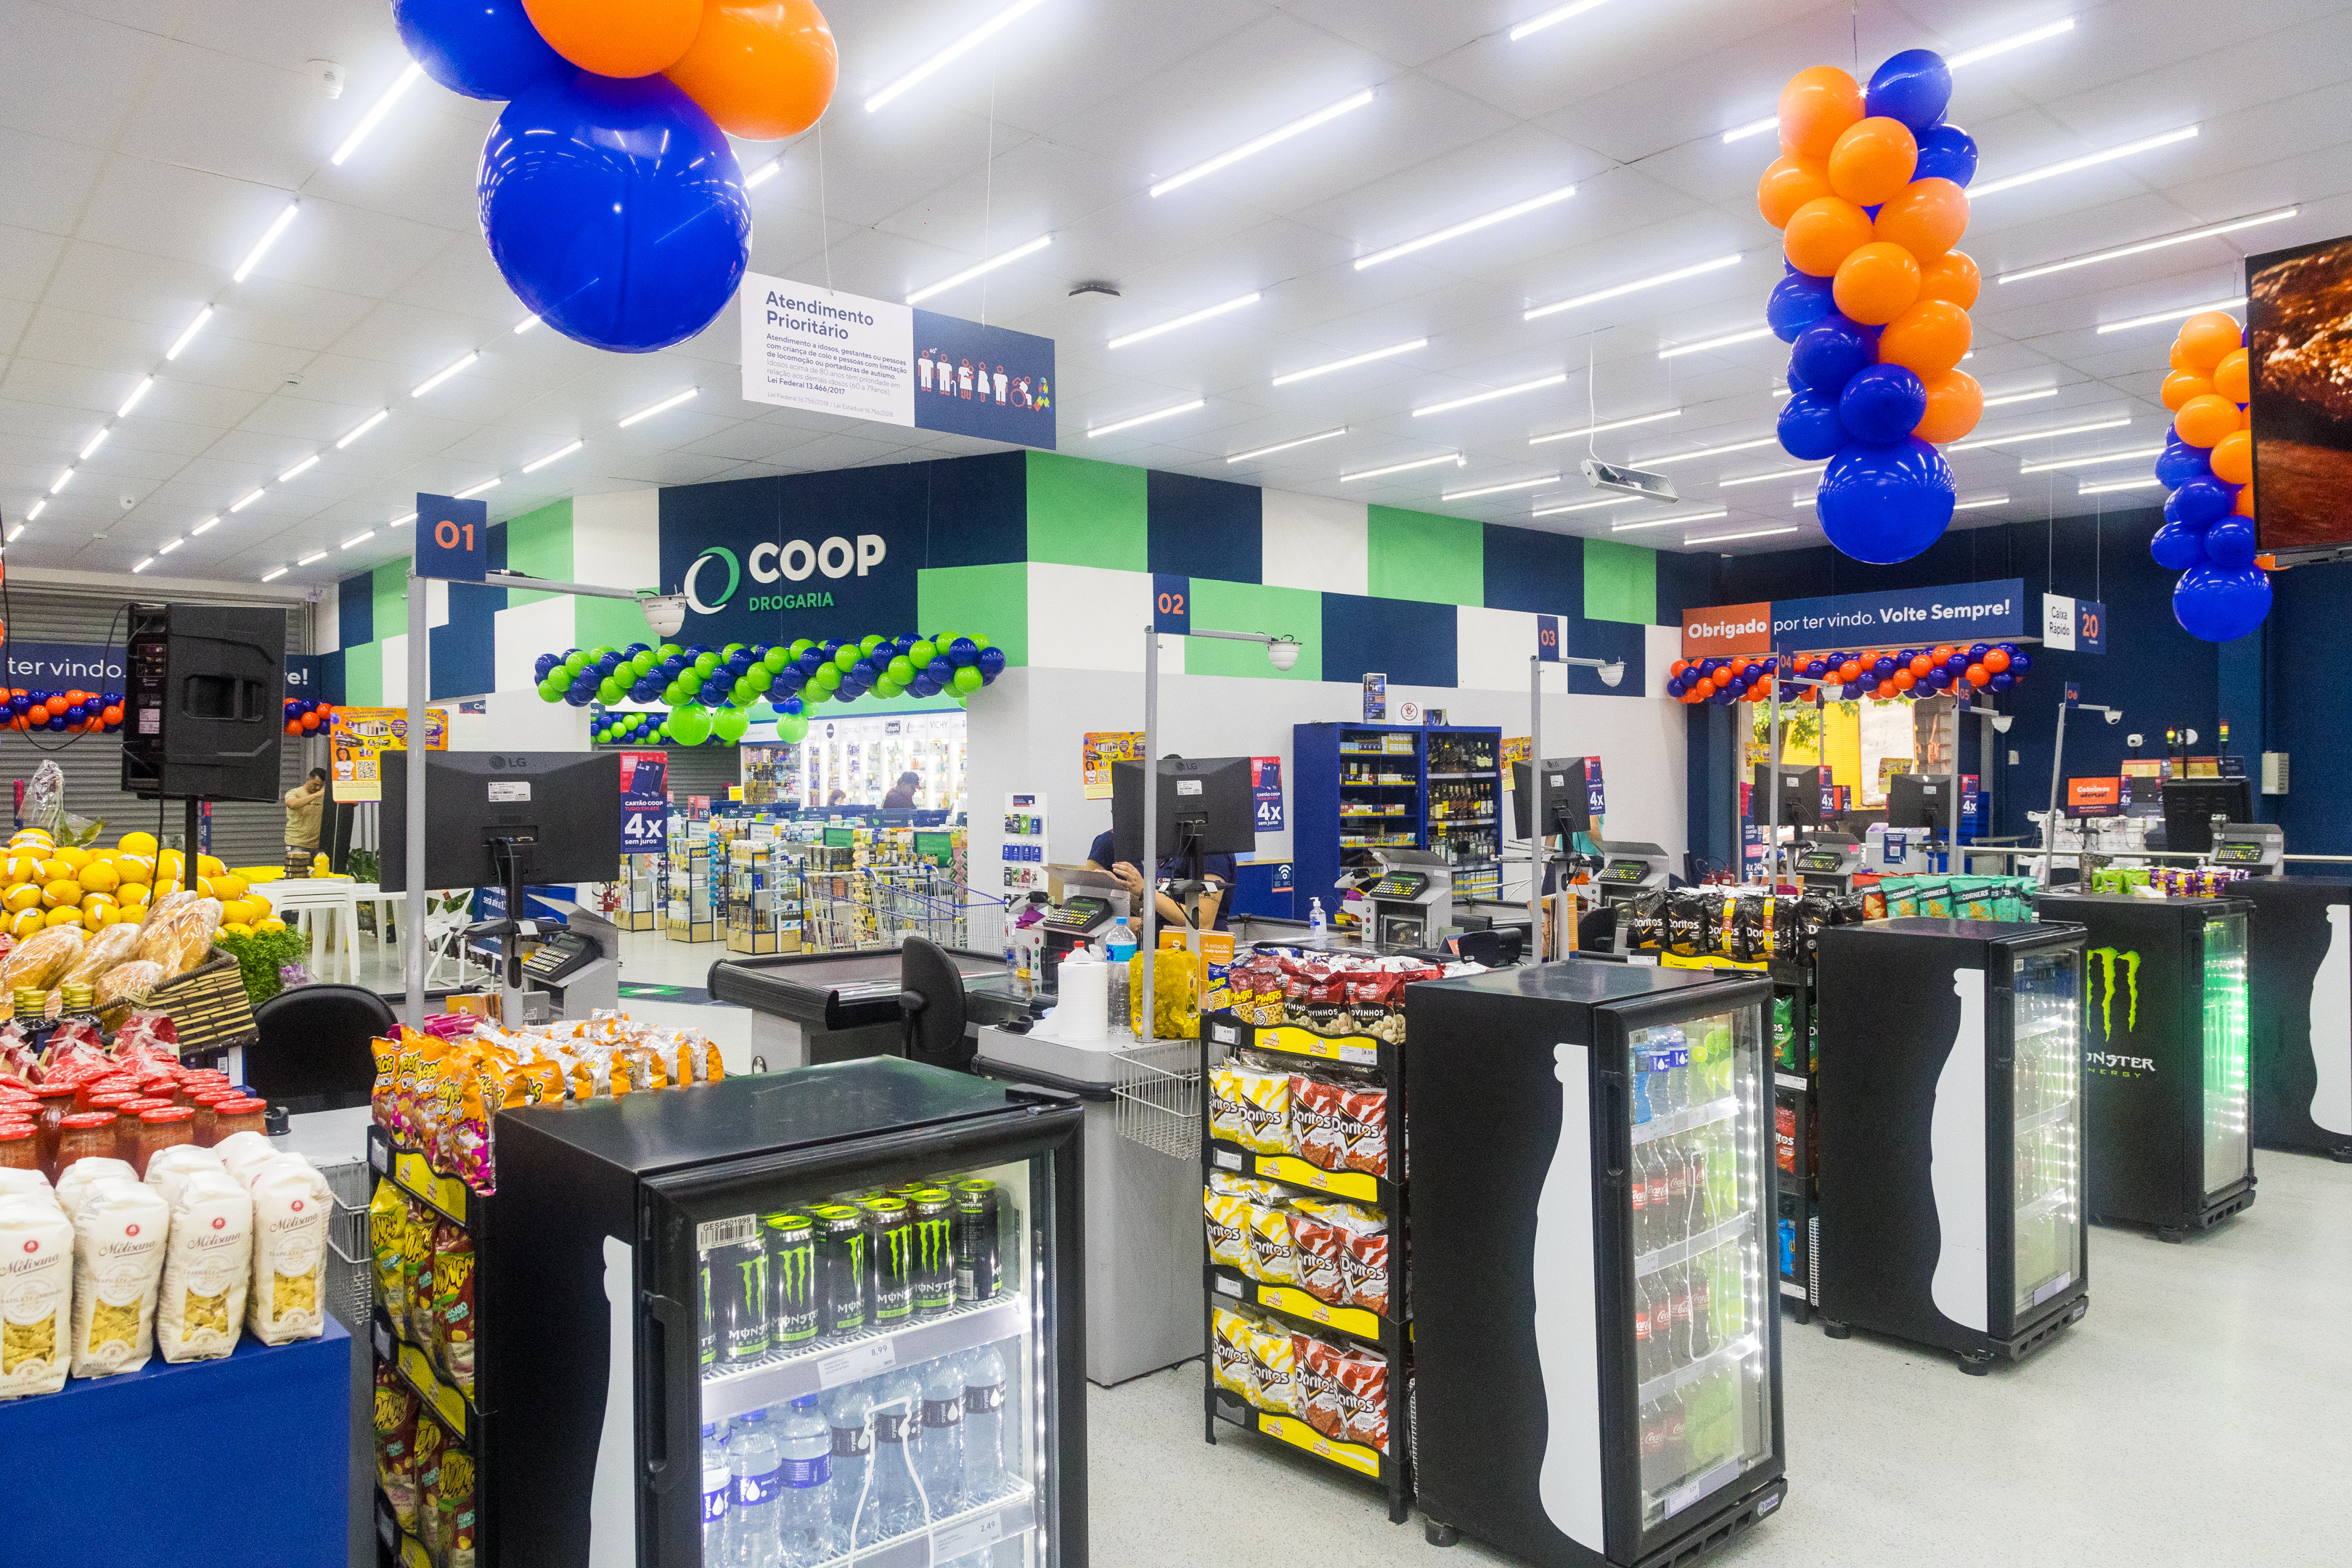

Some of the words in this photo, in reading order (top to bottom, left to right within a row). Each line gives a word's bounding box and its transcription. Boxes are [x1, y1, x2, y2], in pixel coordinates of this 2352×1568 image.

[766, 290, 874, 326] Atendimento
[767, 310, 849, 340] Prioritário
[767, 333, 811, 347] Atendimento
[817, 343, 840, 354] idosos,
[841, 348, 872, 359] gestantes
[882, 356, 907, 366] pessoas
[777, 352, 814, 364] locomoção
[825, 362, 859, 374] portadoras
[870, 369, 897, 380] autismo.
[783, 346, 807, 356] criança
[818, 351, 832, 360] colo
[838, 356, 864, 366] pessoas
[880, 363, 907, 374] limitação
[767, 359, 788, 369] Idosos
[789, 363, 809, 372] acima
[859, 376, 891, 387] prioridade
[767, 369, 791, 377] relação
[805, 375, 828, 384] demais
[829, 378, 848, 388] idosos
[849, 381, 860, 391] (60
[767, 375, 777, 384] Lei
[779, 378, 804, 388] Federal
[806, 383, 845, 395] 13.466/2017
[777, 393, 797, 401] Federal
[842, 404, 864, 412] Estadual
[434, 520, 474, 551] 01
[748, 534, 886, 584] COOP
[749, 592, 834, 611] DROGARIA
[1158, 592, 1184, 616] 02
[1688, 618, 1768, 640] Obrigado
[1774, 619, 1800, 635] por
[1802, 616, 1825, 629] ter
[1827, 609, 1876, 627] vindo.
[1879, 607, 1927, 625] Volte
[1931, 599, 2010, 621] Sempre!
[2051, 606, 2067, 620] Caixa
[2049, 621, 2070, 637] Rápido
[2082, 613, 2099, 638] 20
[1540, 629, 1556, 647] 03
[9, 658, 45, 677] ter
[1779, 655, 1792, 669] 04
[1960, 687, 1969, 701] 05
[2067, 690, 2078, 700] 06
[509, 757, 526, 767] LG
[1590, 791, 1604, 807] 4x
[1821, 793, 1834, 807] 4x
[1963, 800, 1977, 812] 4x
[2120, 794, 2131, 804] 4x
[1257, 801, 1281, 821] 4x
[624, 813, 663, 838] 4x
[1635, 918, 1663, 927] Doritos
[1669, 918, 1699, 930] Doritos
[1708, 924, 1739, 936] Doros
[1747, 926, 1780, 939] Doros
[1284, 1002, 1306, 1012] VINHO
[1308, 1008, 1338, 1017] OVINHOS
[2088, 1067, 2141, 1078] NERGY
[1209, 1095, 1238, 1114] oritos
[1238, 1105, 1282, 1124] Doritos
[1291, 1108, 1332, 1129] Doritos
[1332, 1115, 1381, 1138] Doritos
[1777, 1132, 1794, 1146] itos
[703, 1217, 751, 1232] GESP601999
[1249, 1237, 1291, 1259] Doritos
[1298, 1252, 1334, 1271] ritos
[1341, 1256, 1387, 1281] Doritos
[838, 1297, 865, 1313] MONS
[877, 1287, 915, 1304] MONST
[772, 1308, 819, 1328] MONSTE
[729, 1321, 769, 1342] MONST
[871, 1344, 888, 1356] 8,99
[1213, 1338, 1249, 1365] Doritos
[1250, 1363, 1290, 1385] Doritos
[1295, 1365, 1336, 1394] Doritos
[1335, 1392, 1376, 1413] Doritos
[980, 1521, 995, 1532] 2,49
